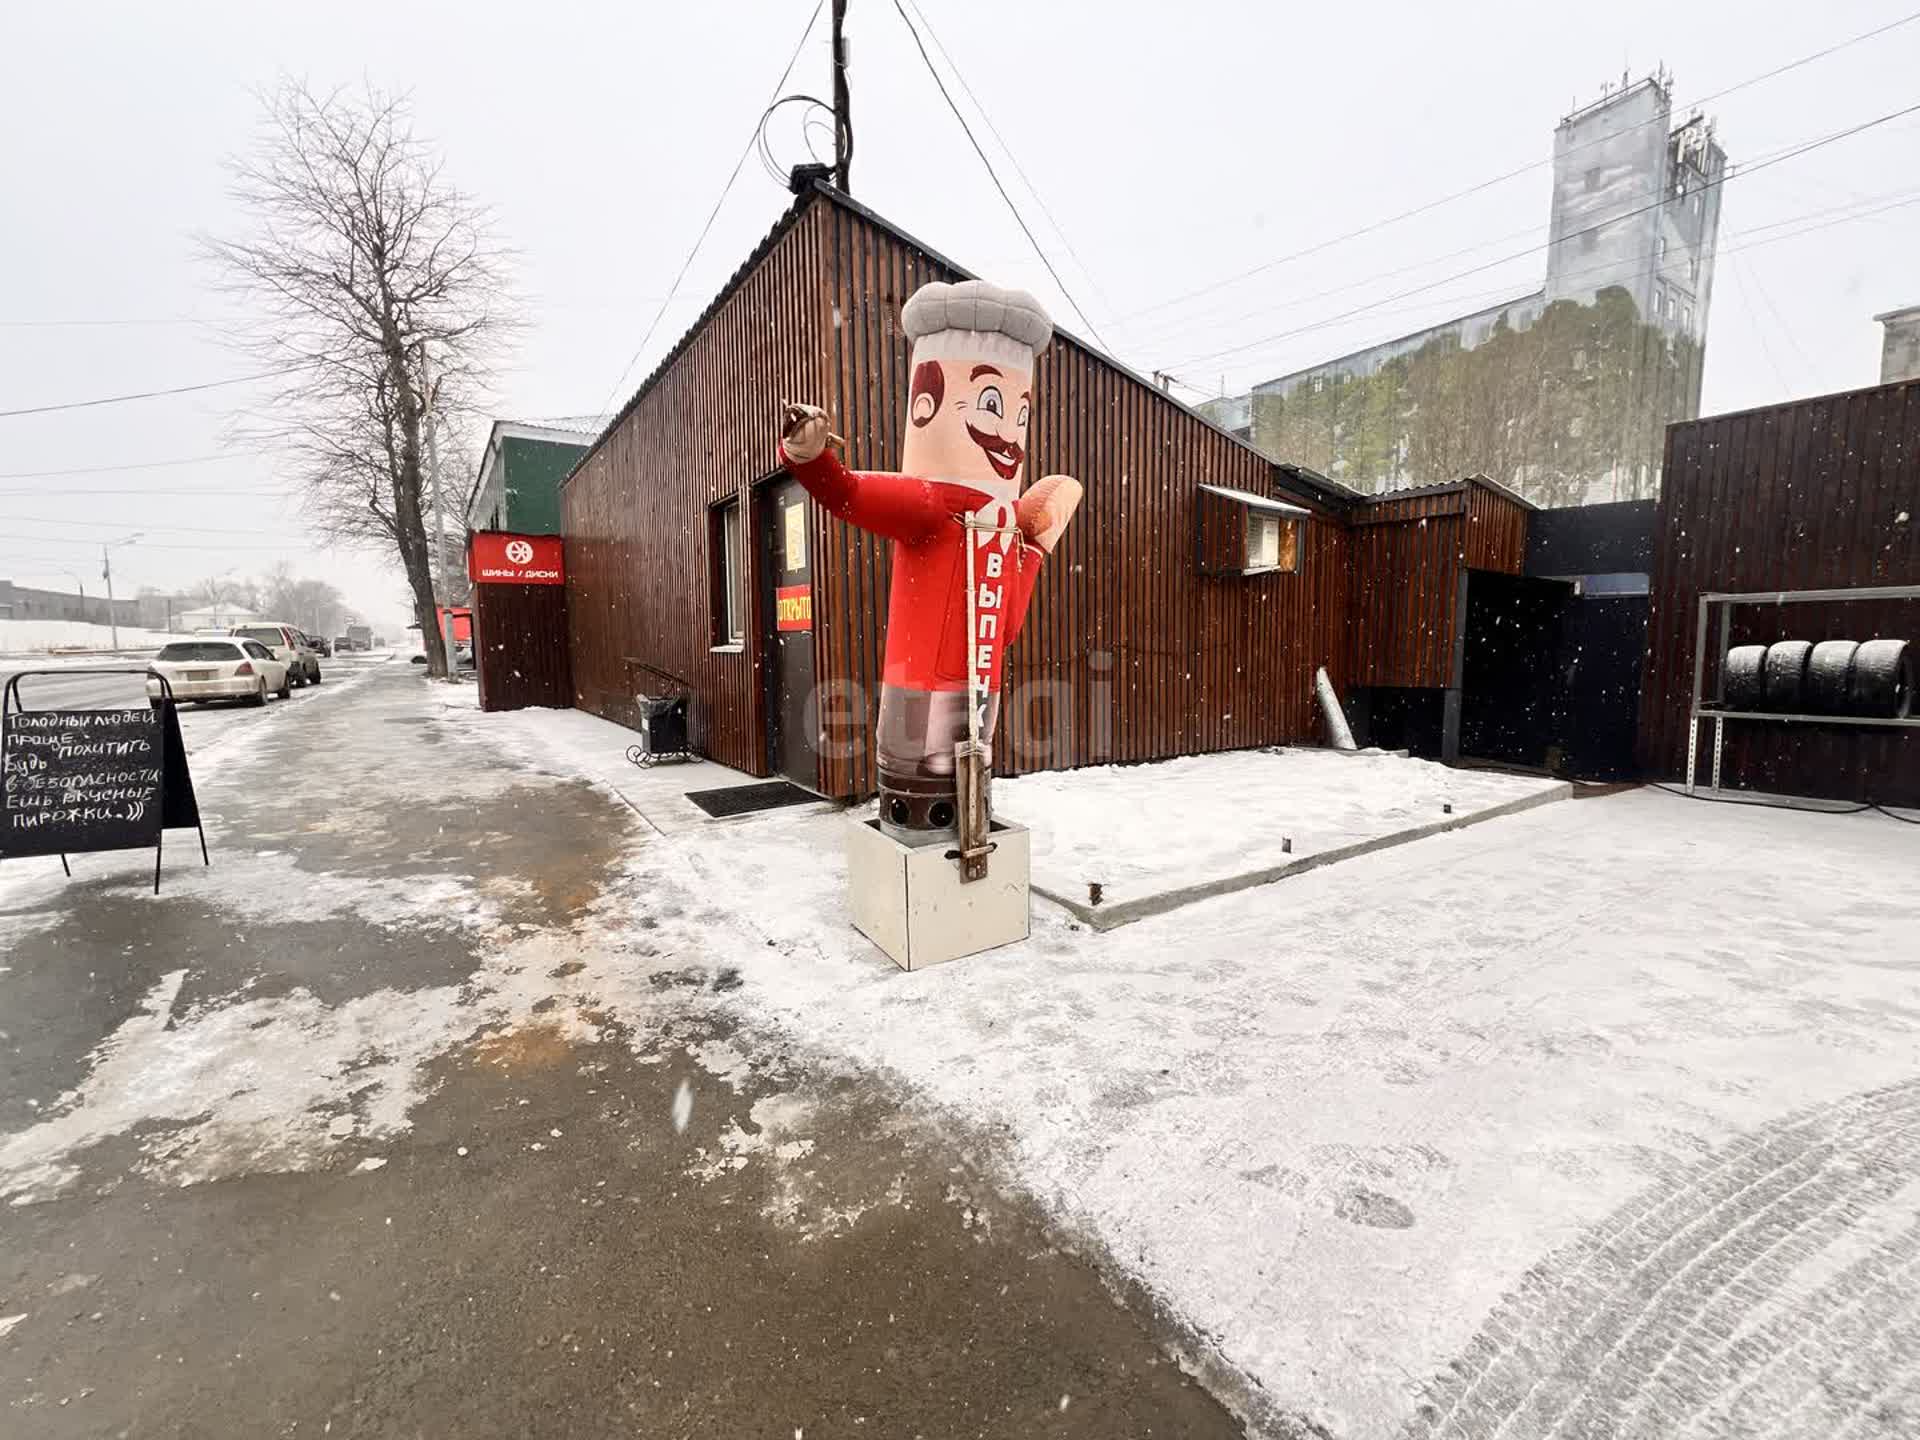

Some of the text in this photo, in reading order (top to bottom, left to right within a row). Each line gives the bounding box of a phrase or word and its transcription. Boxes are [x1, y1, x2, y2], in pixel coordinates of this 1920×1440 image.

[482, 568, 515, 577] ШИНЫ
[525, 570, 559, 578] ДИСКИ
[778, 596, 811, 621] ОТКРЫТО
[974, 552, 1003, 740] ВЫПЕЧК
